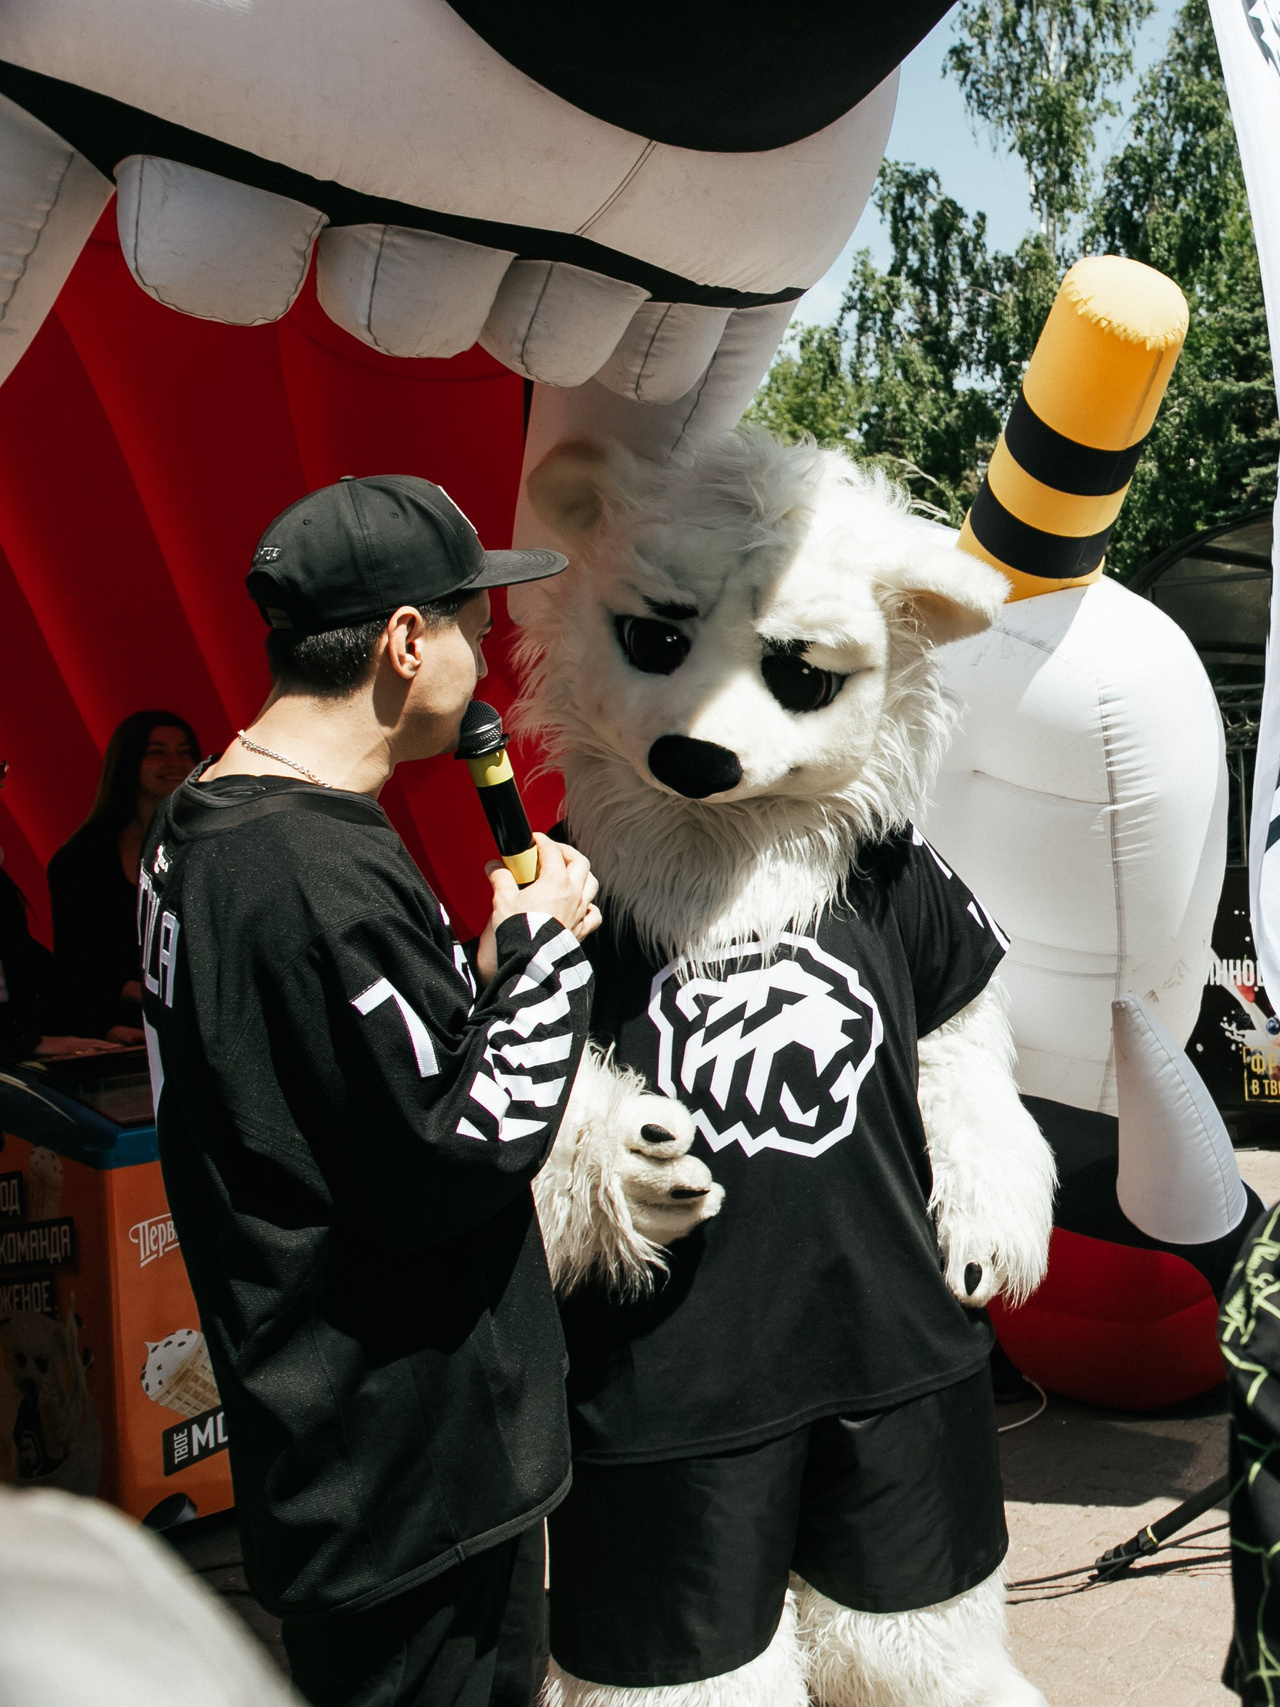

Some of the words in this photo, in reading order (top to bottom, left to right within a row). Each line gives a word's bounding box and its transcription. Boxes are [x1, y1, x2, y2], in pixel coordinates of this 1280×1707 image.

[349, 976, 441, 1079] 7
[1251, 1079, 1260, 1096] В
[0, 1224, 71, 1264] КОМАНДА
[129, 1214, 180, 1263] Перв
[173, 1428, 189, 1465] ТВОЕ
